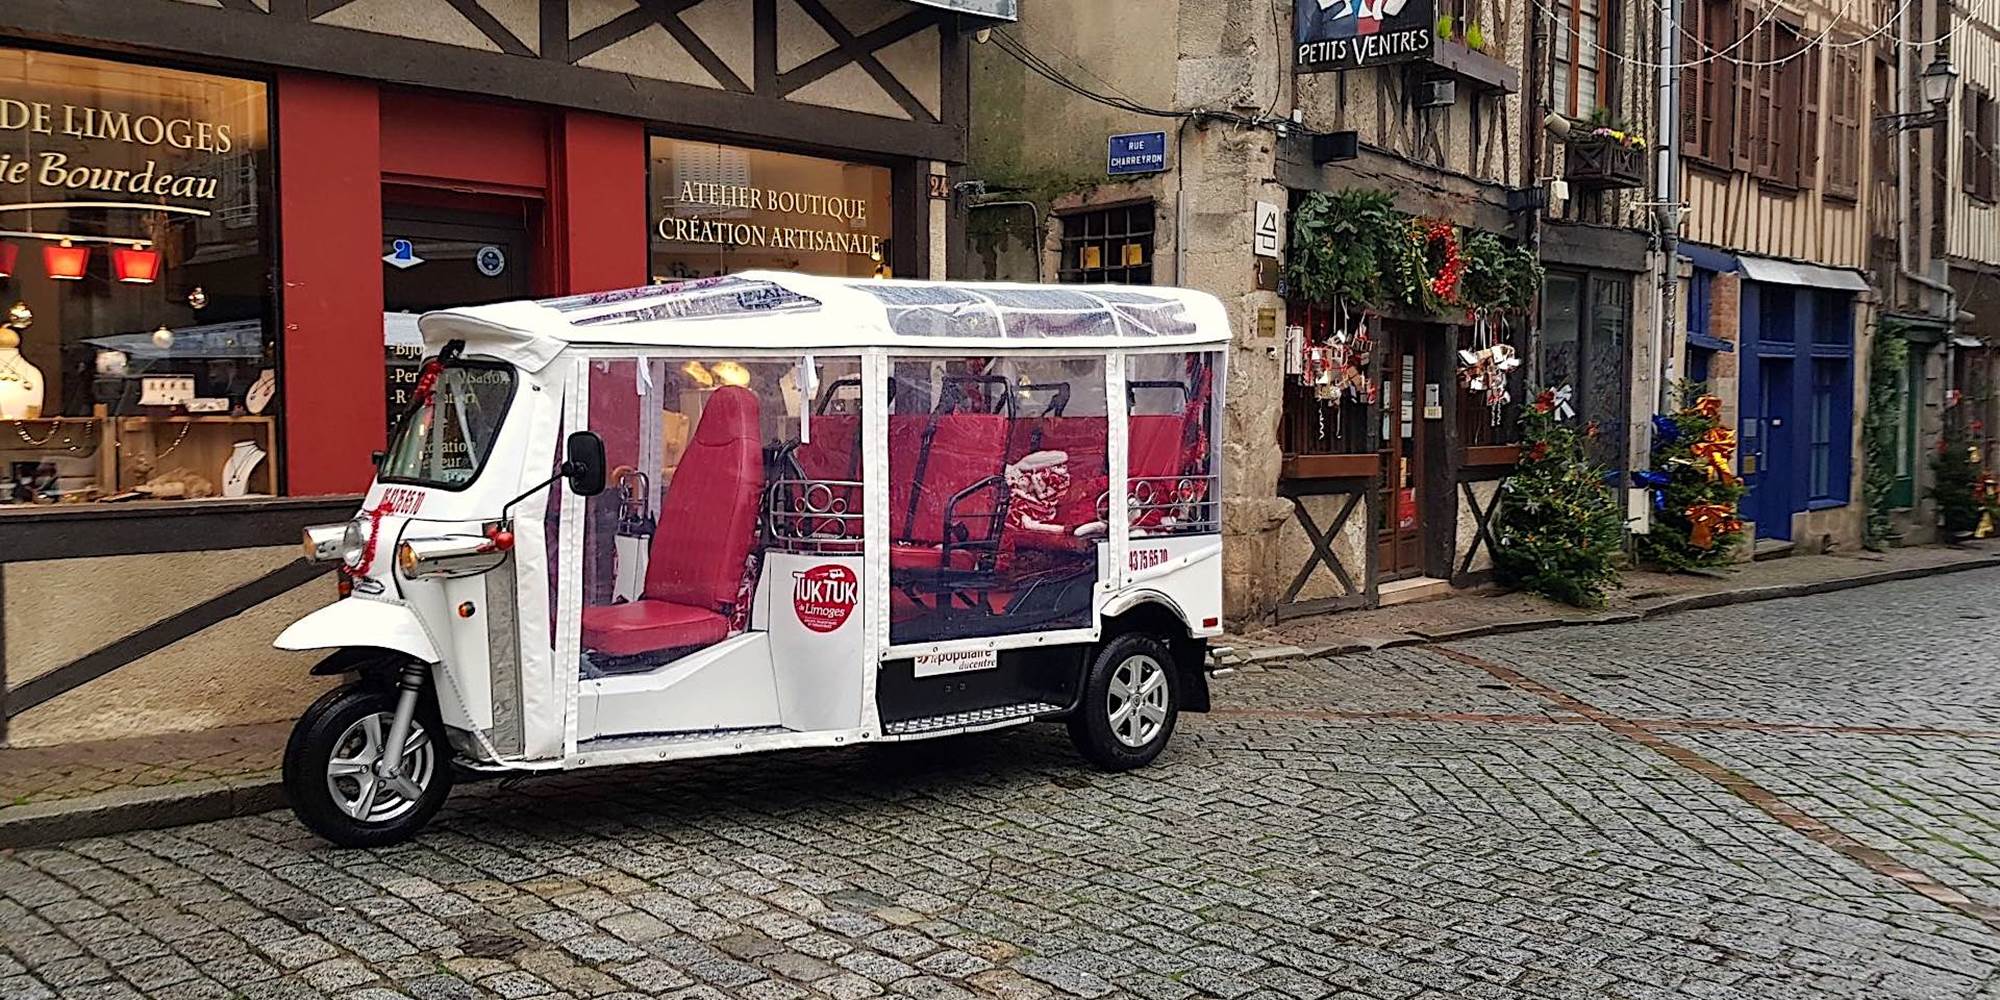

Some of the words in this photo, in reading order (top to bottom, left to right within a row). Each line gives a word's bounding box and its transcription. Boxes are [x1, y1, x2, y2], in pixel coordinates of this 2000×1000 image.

[1299, 40, 1347, 64] PETITS
[1352, 29, 1429, 65] VENTRES
[0, 98, 52, 135] DE
[62, 104, 233, 155] LIMOGES
[1110, 153, 1163, 168] CHARREYRON
[1128, 140, 1145, 150] RUE
[38, 152, 218, 200] Bourdeau
[930, 175, 949, 197] 24
[680, 180, 764, 210] ATELIER
[767, 191, 867, 222] BOUTIQUE
[658, 214, 766, 247] CRÉATION
[770, 228, 881, 256] ARTISANALE
[1149, 549, 1159, 567] 65
[792, 572, 823, 603] TUK
[823, 579, 857, 605] TUK
[805, 603, 846, 619] Limoges
